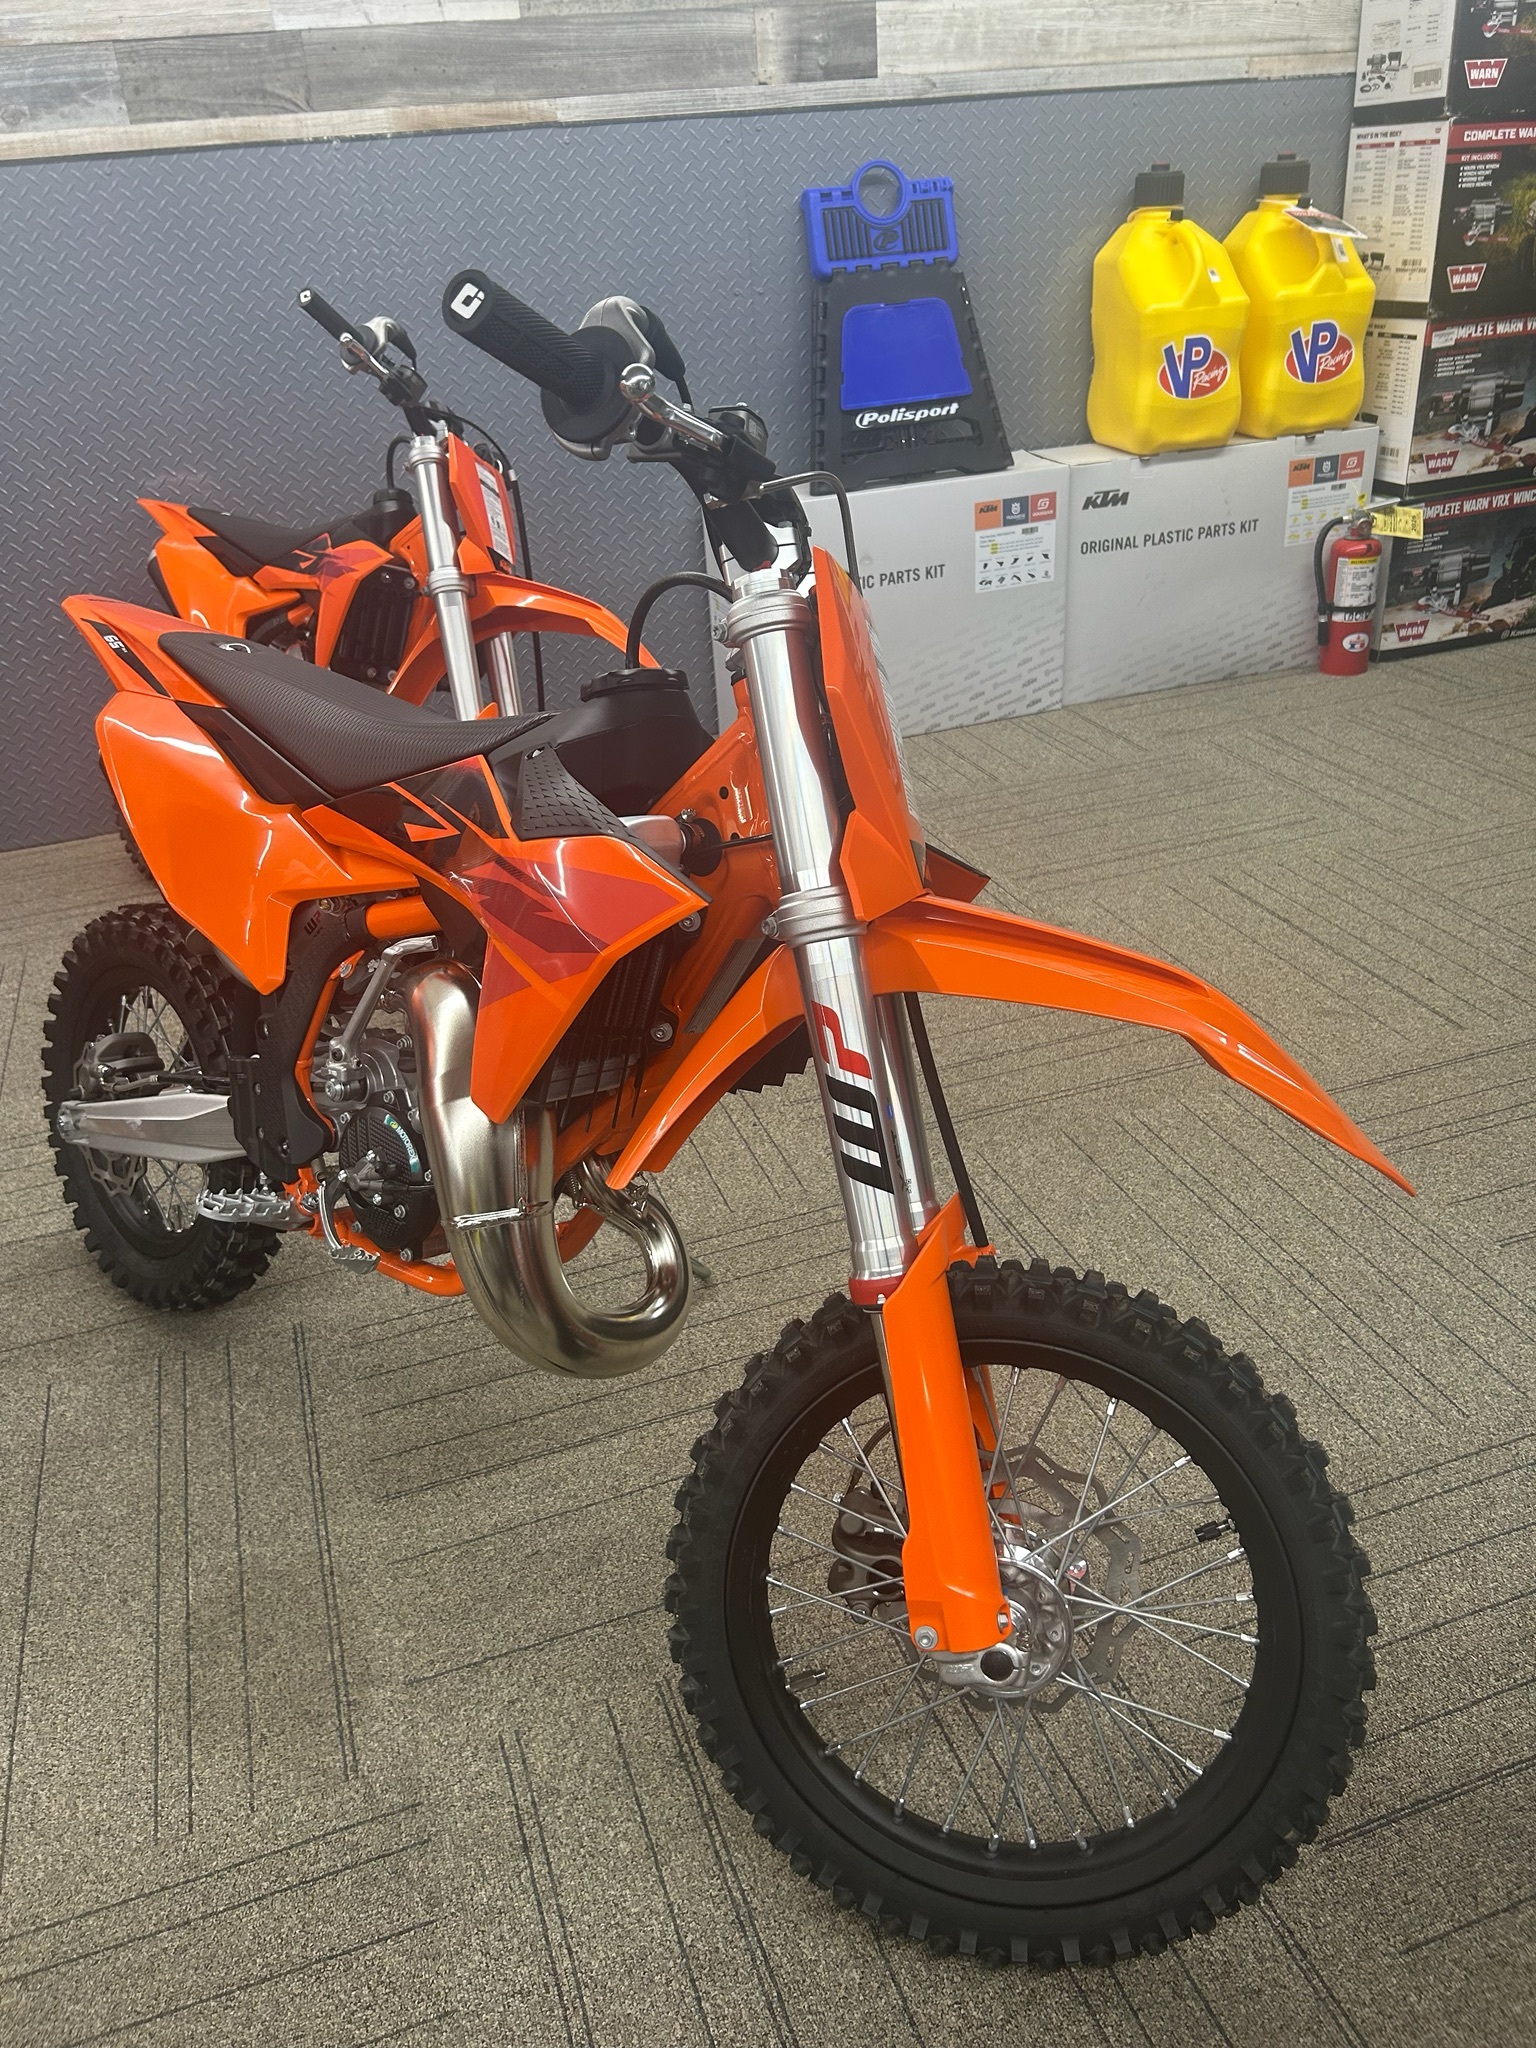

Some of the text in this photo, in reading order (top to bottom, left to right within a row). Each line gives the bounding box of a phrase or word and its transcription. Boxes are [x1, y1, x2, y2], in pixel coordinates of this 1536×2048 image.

[1470, 67, 1498, 80] WARN
[1463, 128, 1517, 142] COMPLETE
[1452, 271, 1479, 285] WARN
[1446, 321, 1495, 340] MPLETE
[1496, 318, 1524, 335] WARN
[1290, 321, 1339, 383] VP
[1319, 348, 1355, 375] Racing
[1162, 335, 1213, 399] VP
[1193, 364, 1230, 391] Racing
[856, 402, 960, 429] Polisport
[1428, 456, 1454, 469] WARN
[978, 504, 998, 514] KTM
[1081, 489, 1130, 510] KTM
[1463, 498, 1489, 513] WARN
[1492, 493, 1510, 508] VRX
[1080, 519, 1259, 555] ORIGINAL PLASTIC PARTS KIT
[879, 568, 921, 588] PARTS
[925, 564, 946, 580] KIT
[1399, 625, 1425, 637] WARN
[103, 634, 125, 650] 65
[395, 1125, 418, 1162] MOTOREX
